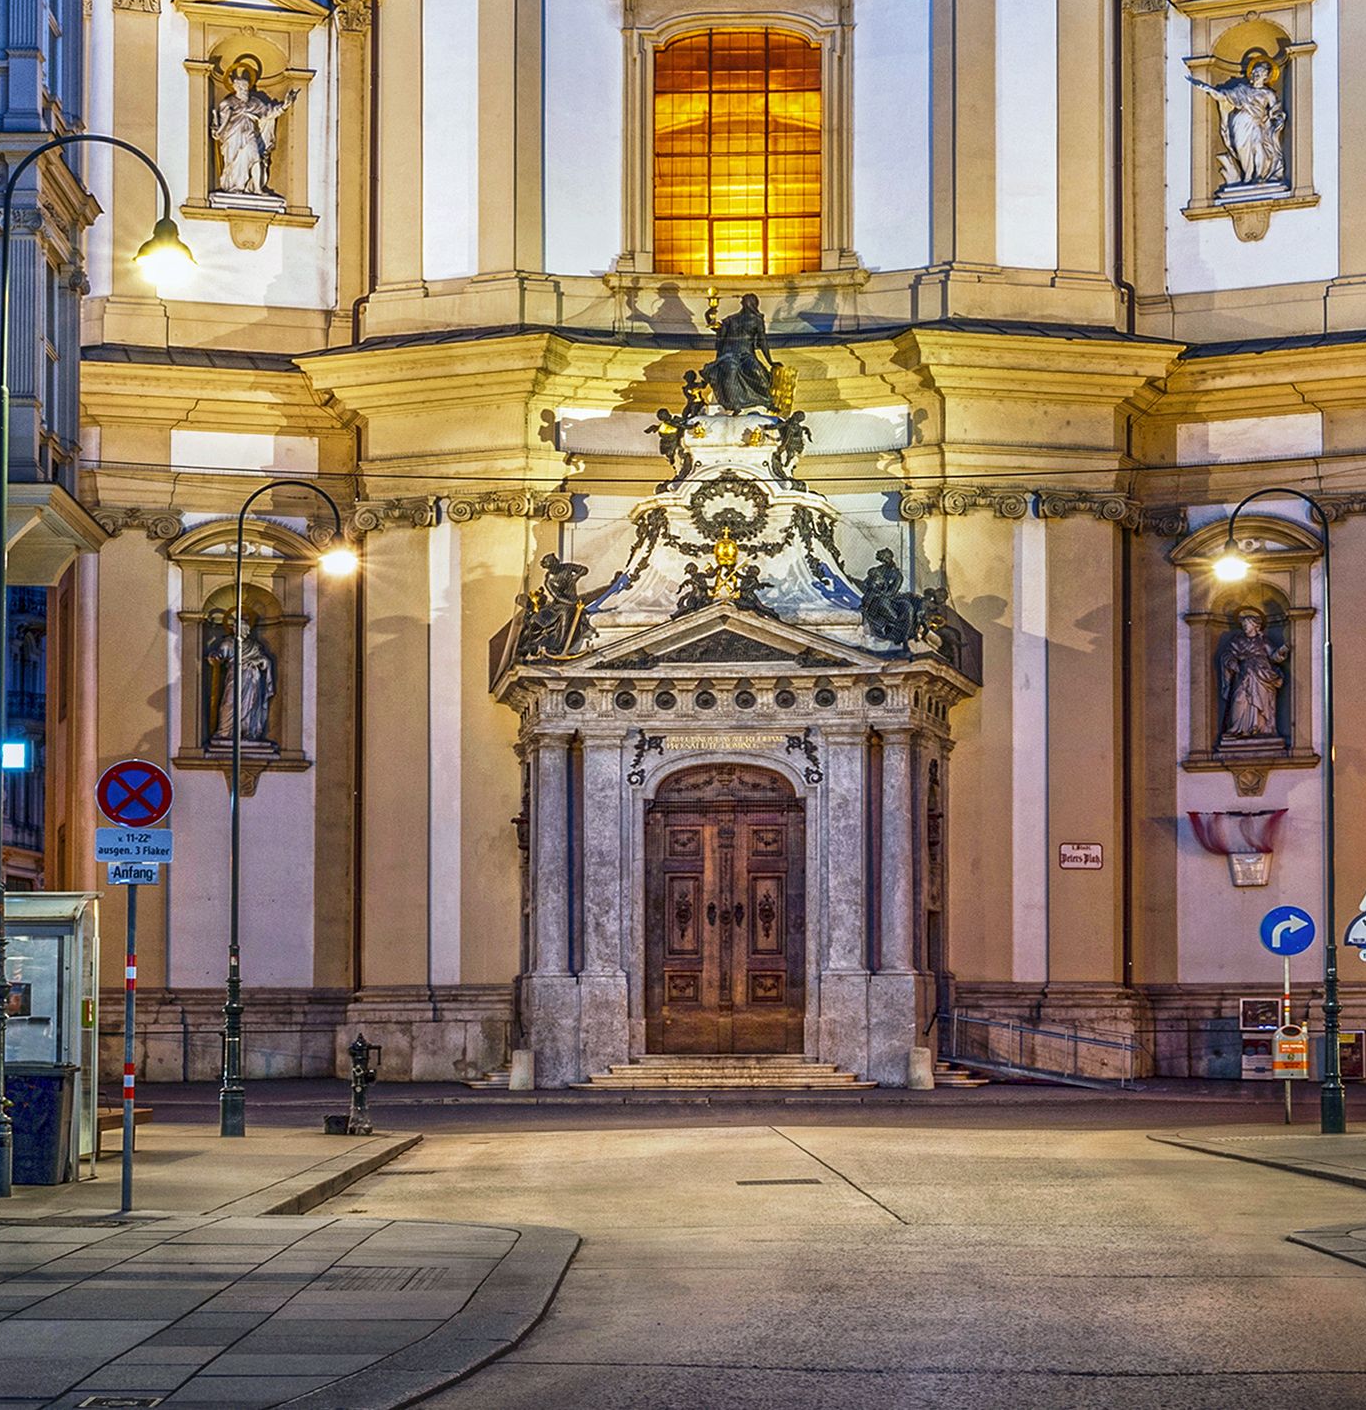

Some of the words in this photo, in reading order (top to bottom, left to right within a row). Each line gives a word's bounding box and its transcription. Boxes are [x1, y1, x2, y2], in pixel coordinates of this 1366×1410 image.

[98, 846, 133, 857] ausgen.
[135, 845, 141, 855] 3
[143, 845, 170, 855] Fiaker
